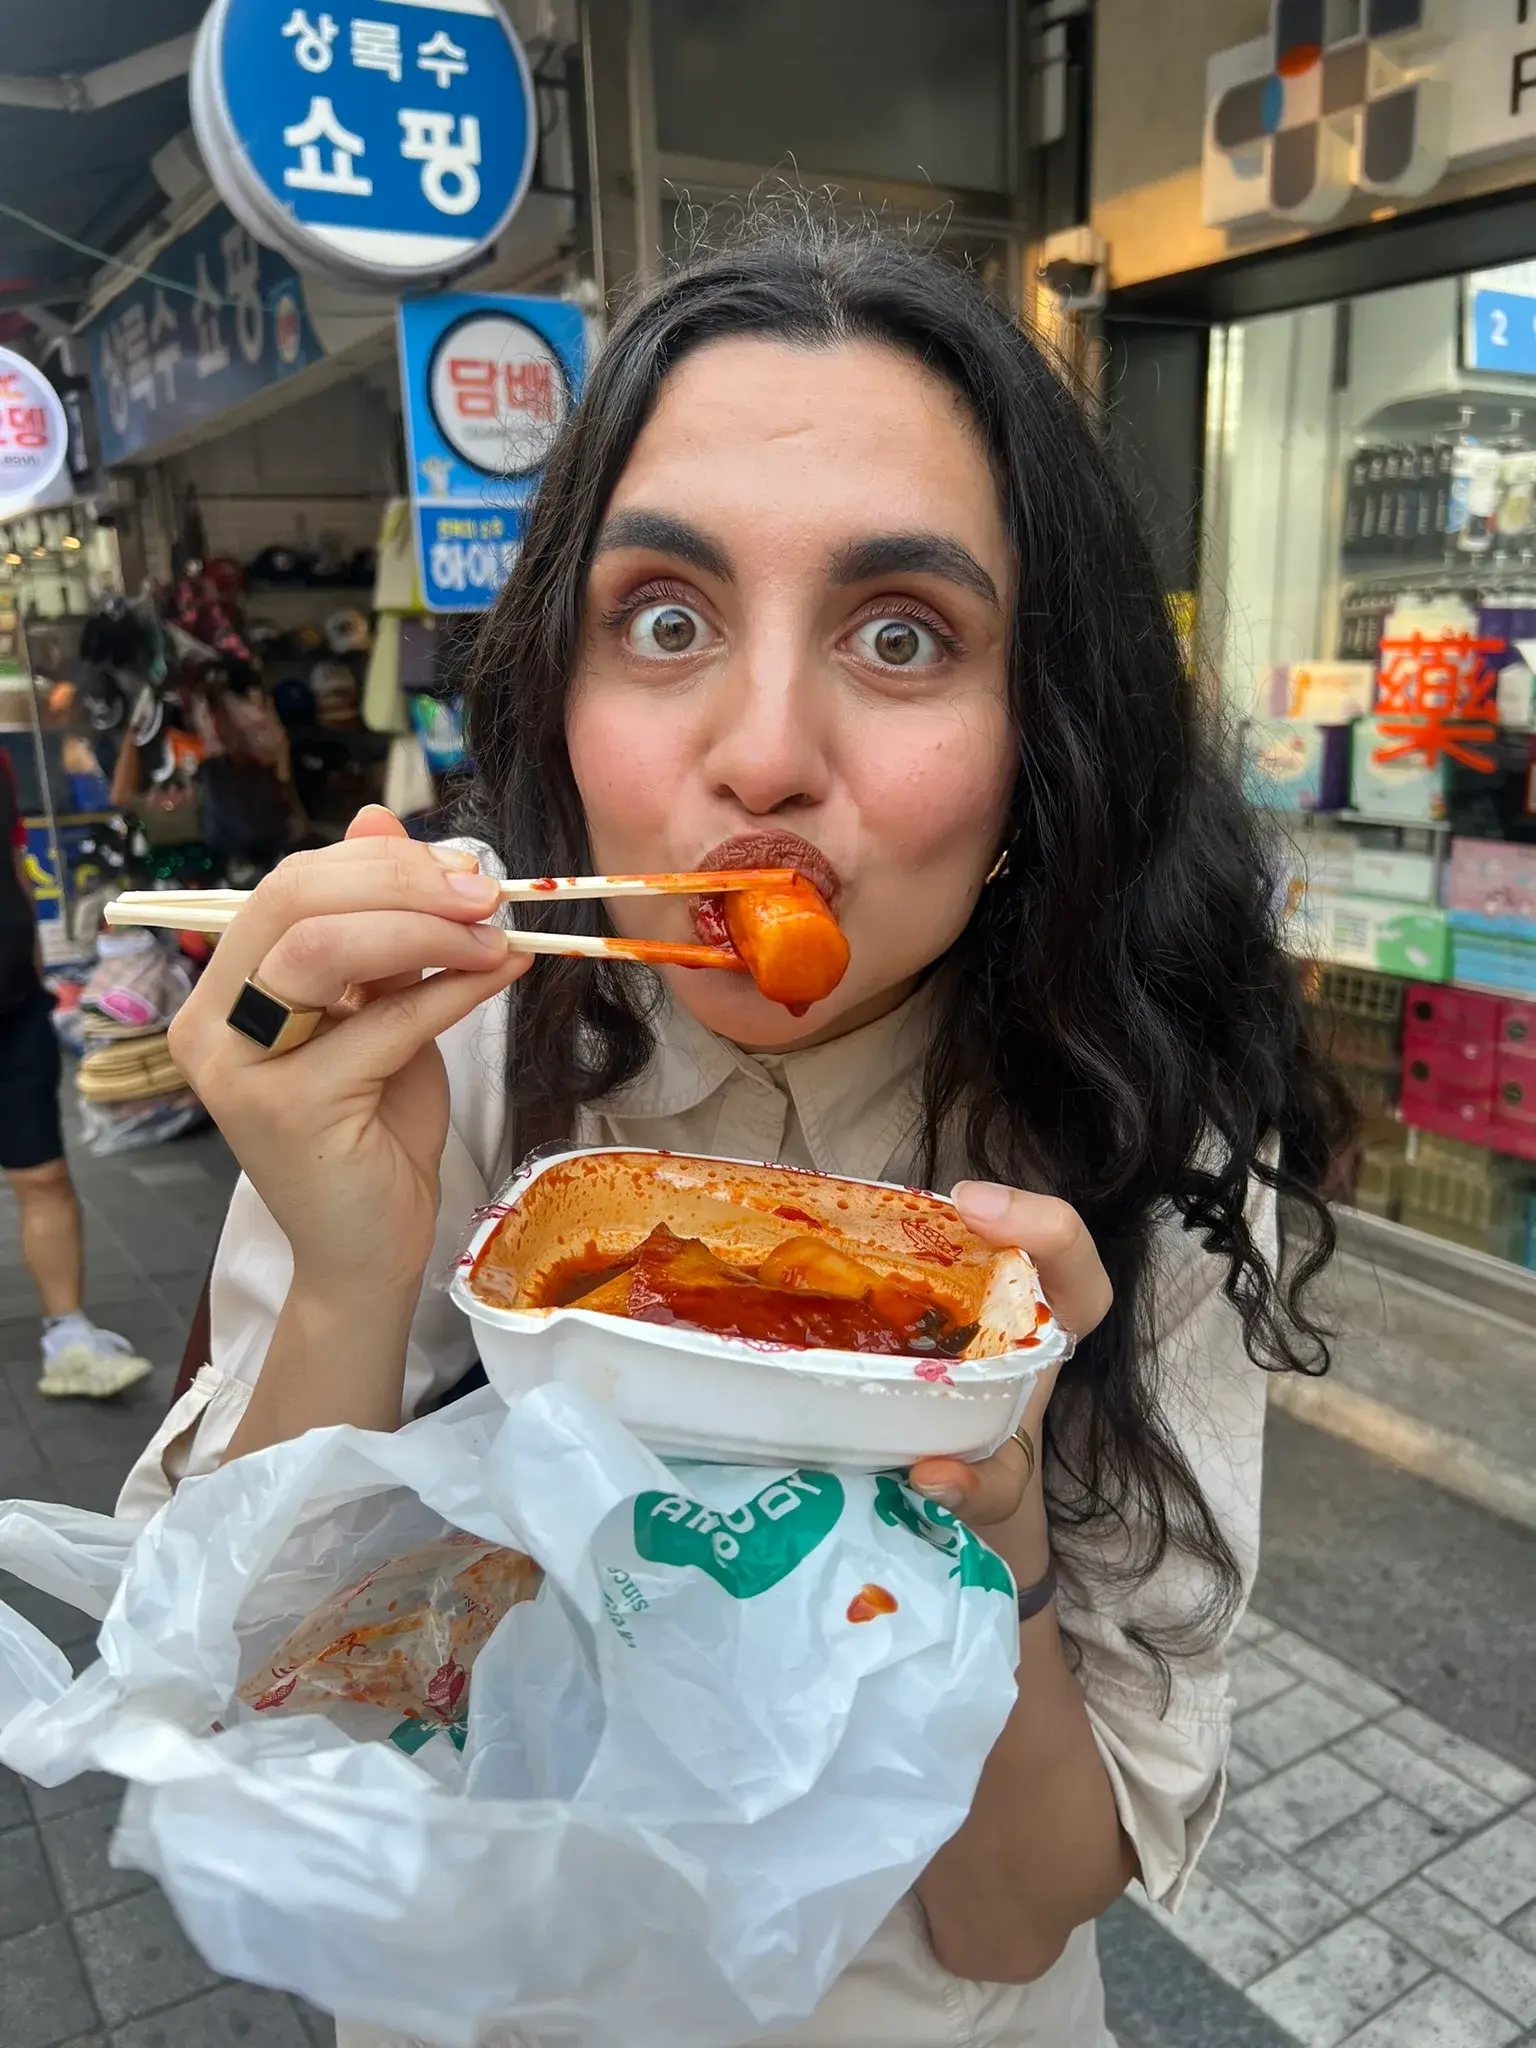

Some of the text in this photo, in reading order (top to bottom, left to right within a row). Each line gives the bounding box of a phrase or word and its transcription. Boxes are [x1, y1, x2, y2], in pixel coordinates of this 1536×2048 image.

[282, 9, 470, 89] 상록수
[282, 96, 482, 216] 쇼핑
[101, 224, 265, 436] 상록수 쇼핑
[1373, 631, 1506, 773] 藥
